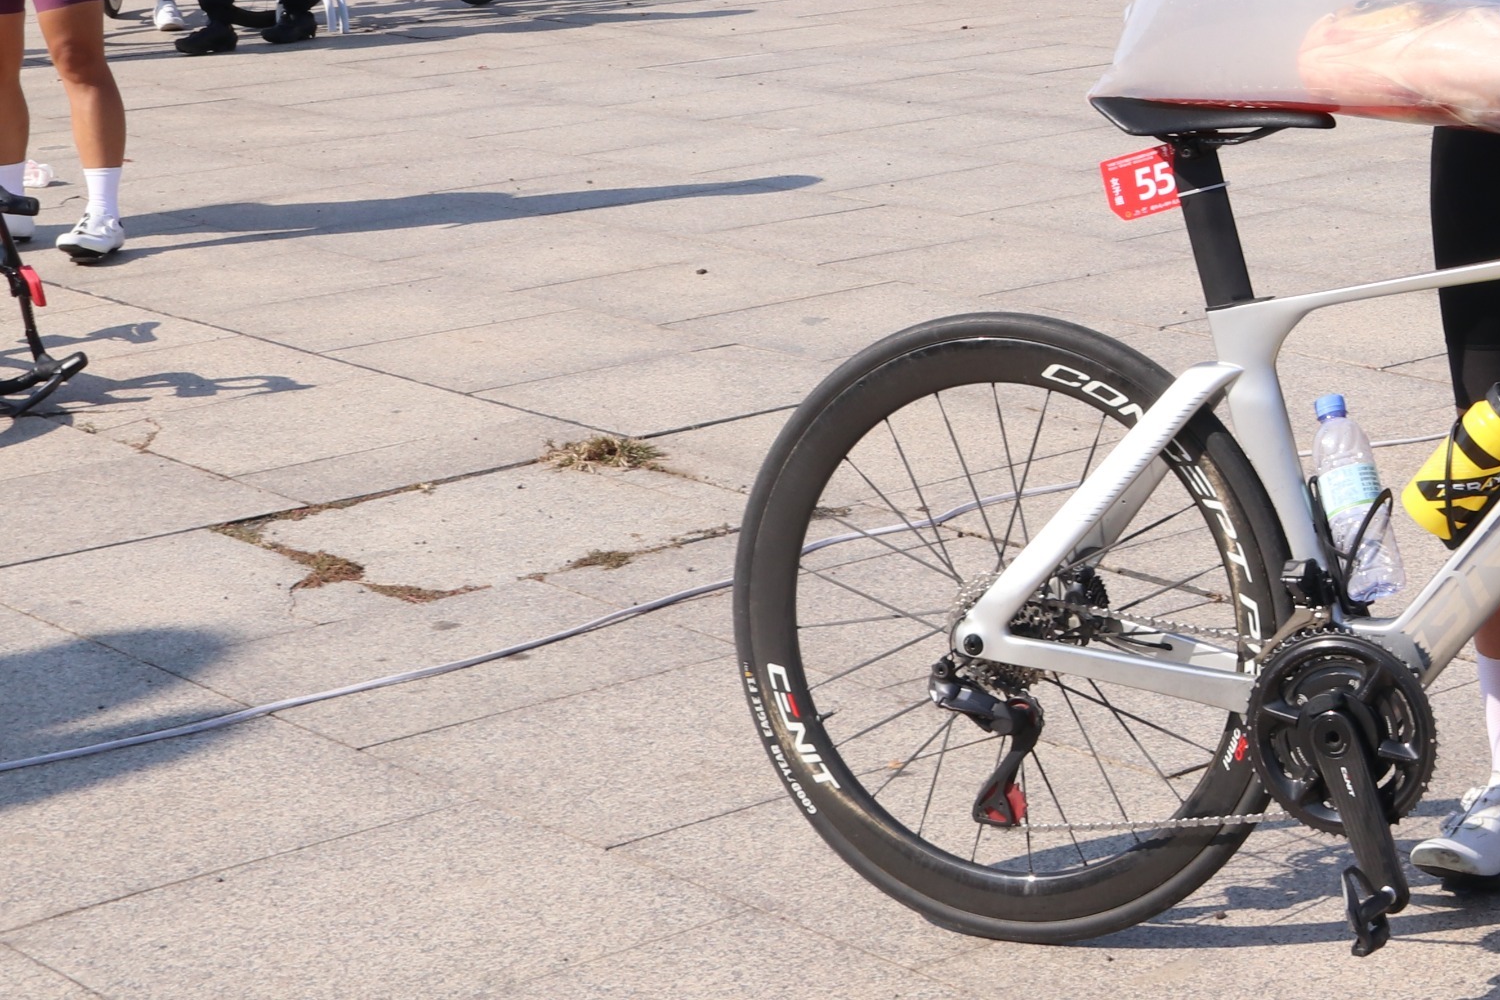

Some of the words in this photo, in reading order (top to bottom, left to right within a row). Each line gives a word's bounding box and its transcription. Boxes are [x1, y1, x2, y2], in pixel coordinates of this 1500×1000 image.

[1134, 161, 1176, 201] 55
[751, 696, 774, 738] EAGLE
[767, 663, 841, 789] CENIT
